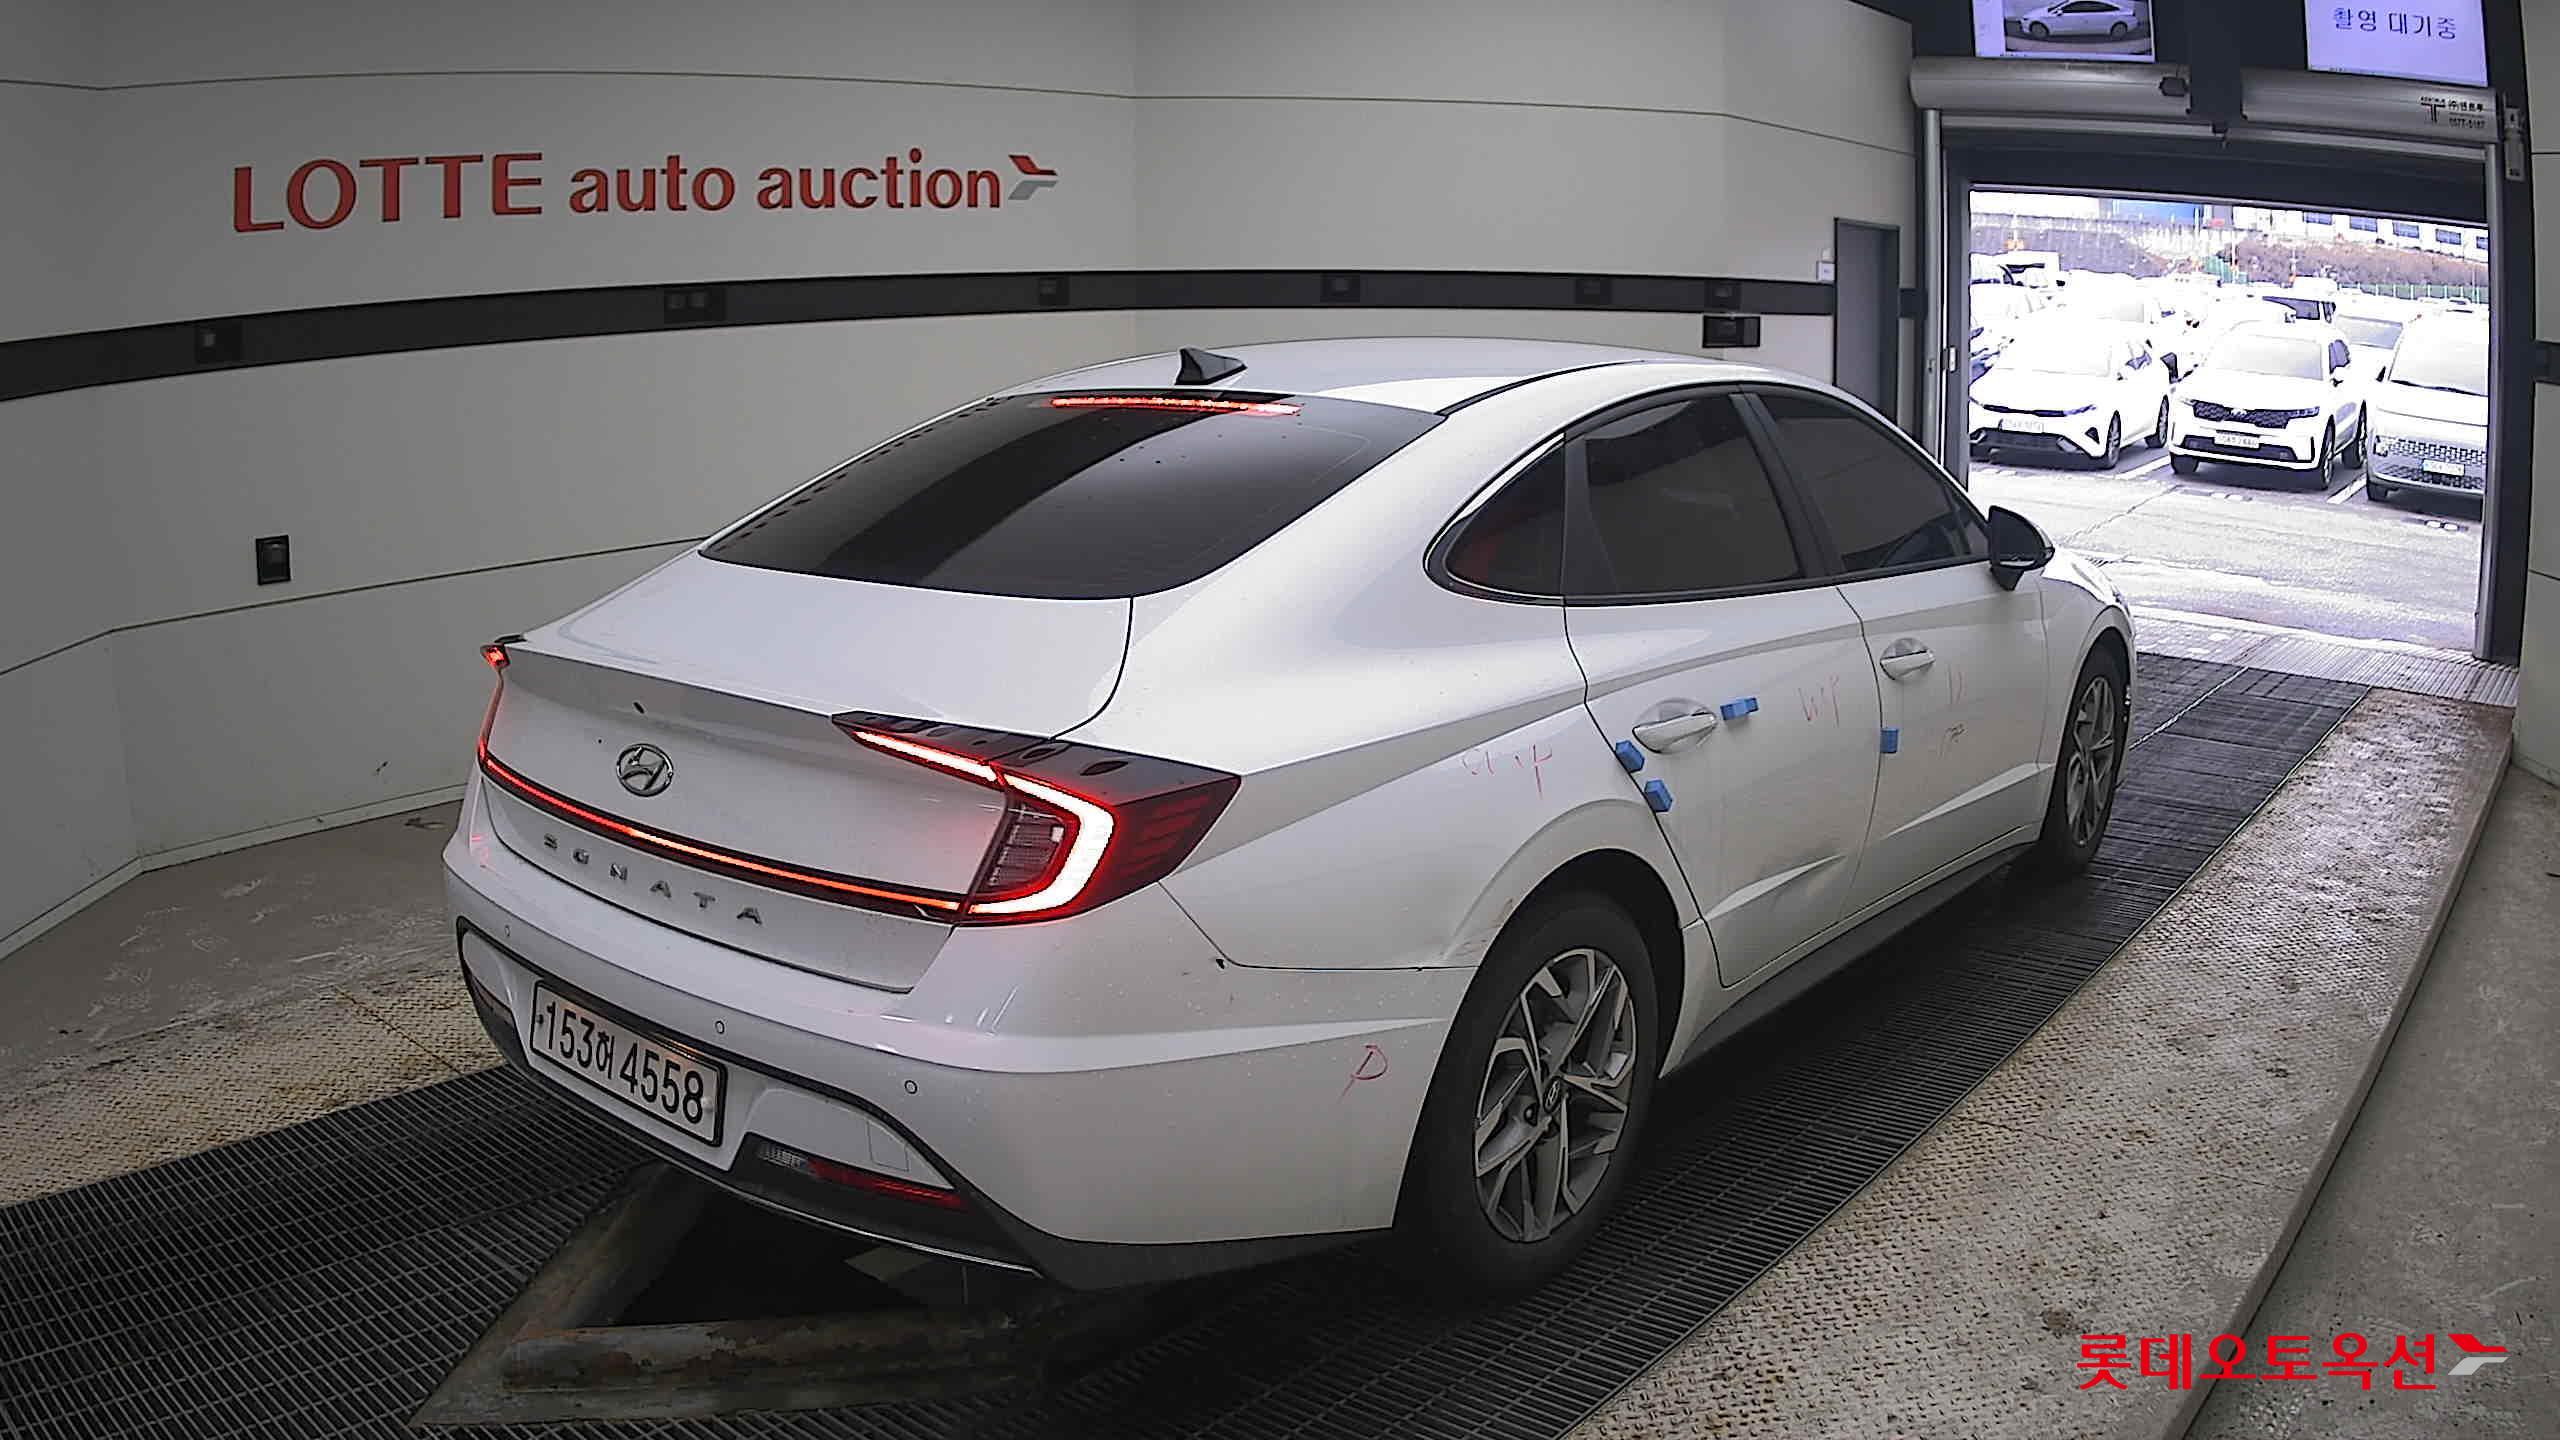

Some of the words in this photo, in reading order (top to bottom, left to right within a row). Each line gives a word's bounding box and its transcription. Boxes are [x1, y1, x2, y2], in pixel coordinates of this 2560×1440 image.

[2333, 8, 2377, 31] 촬영
[234, 153, 542, 233] LOTTE
[569, 155, 737, 214] auto
[756, 148, 1002, 210] auction
[543, 833, 763, 925] SONATA
